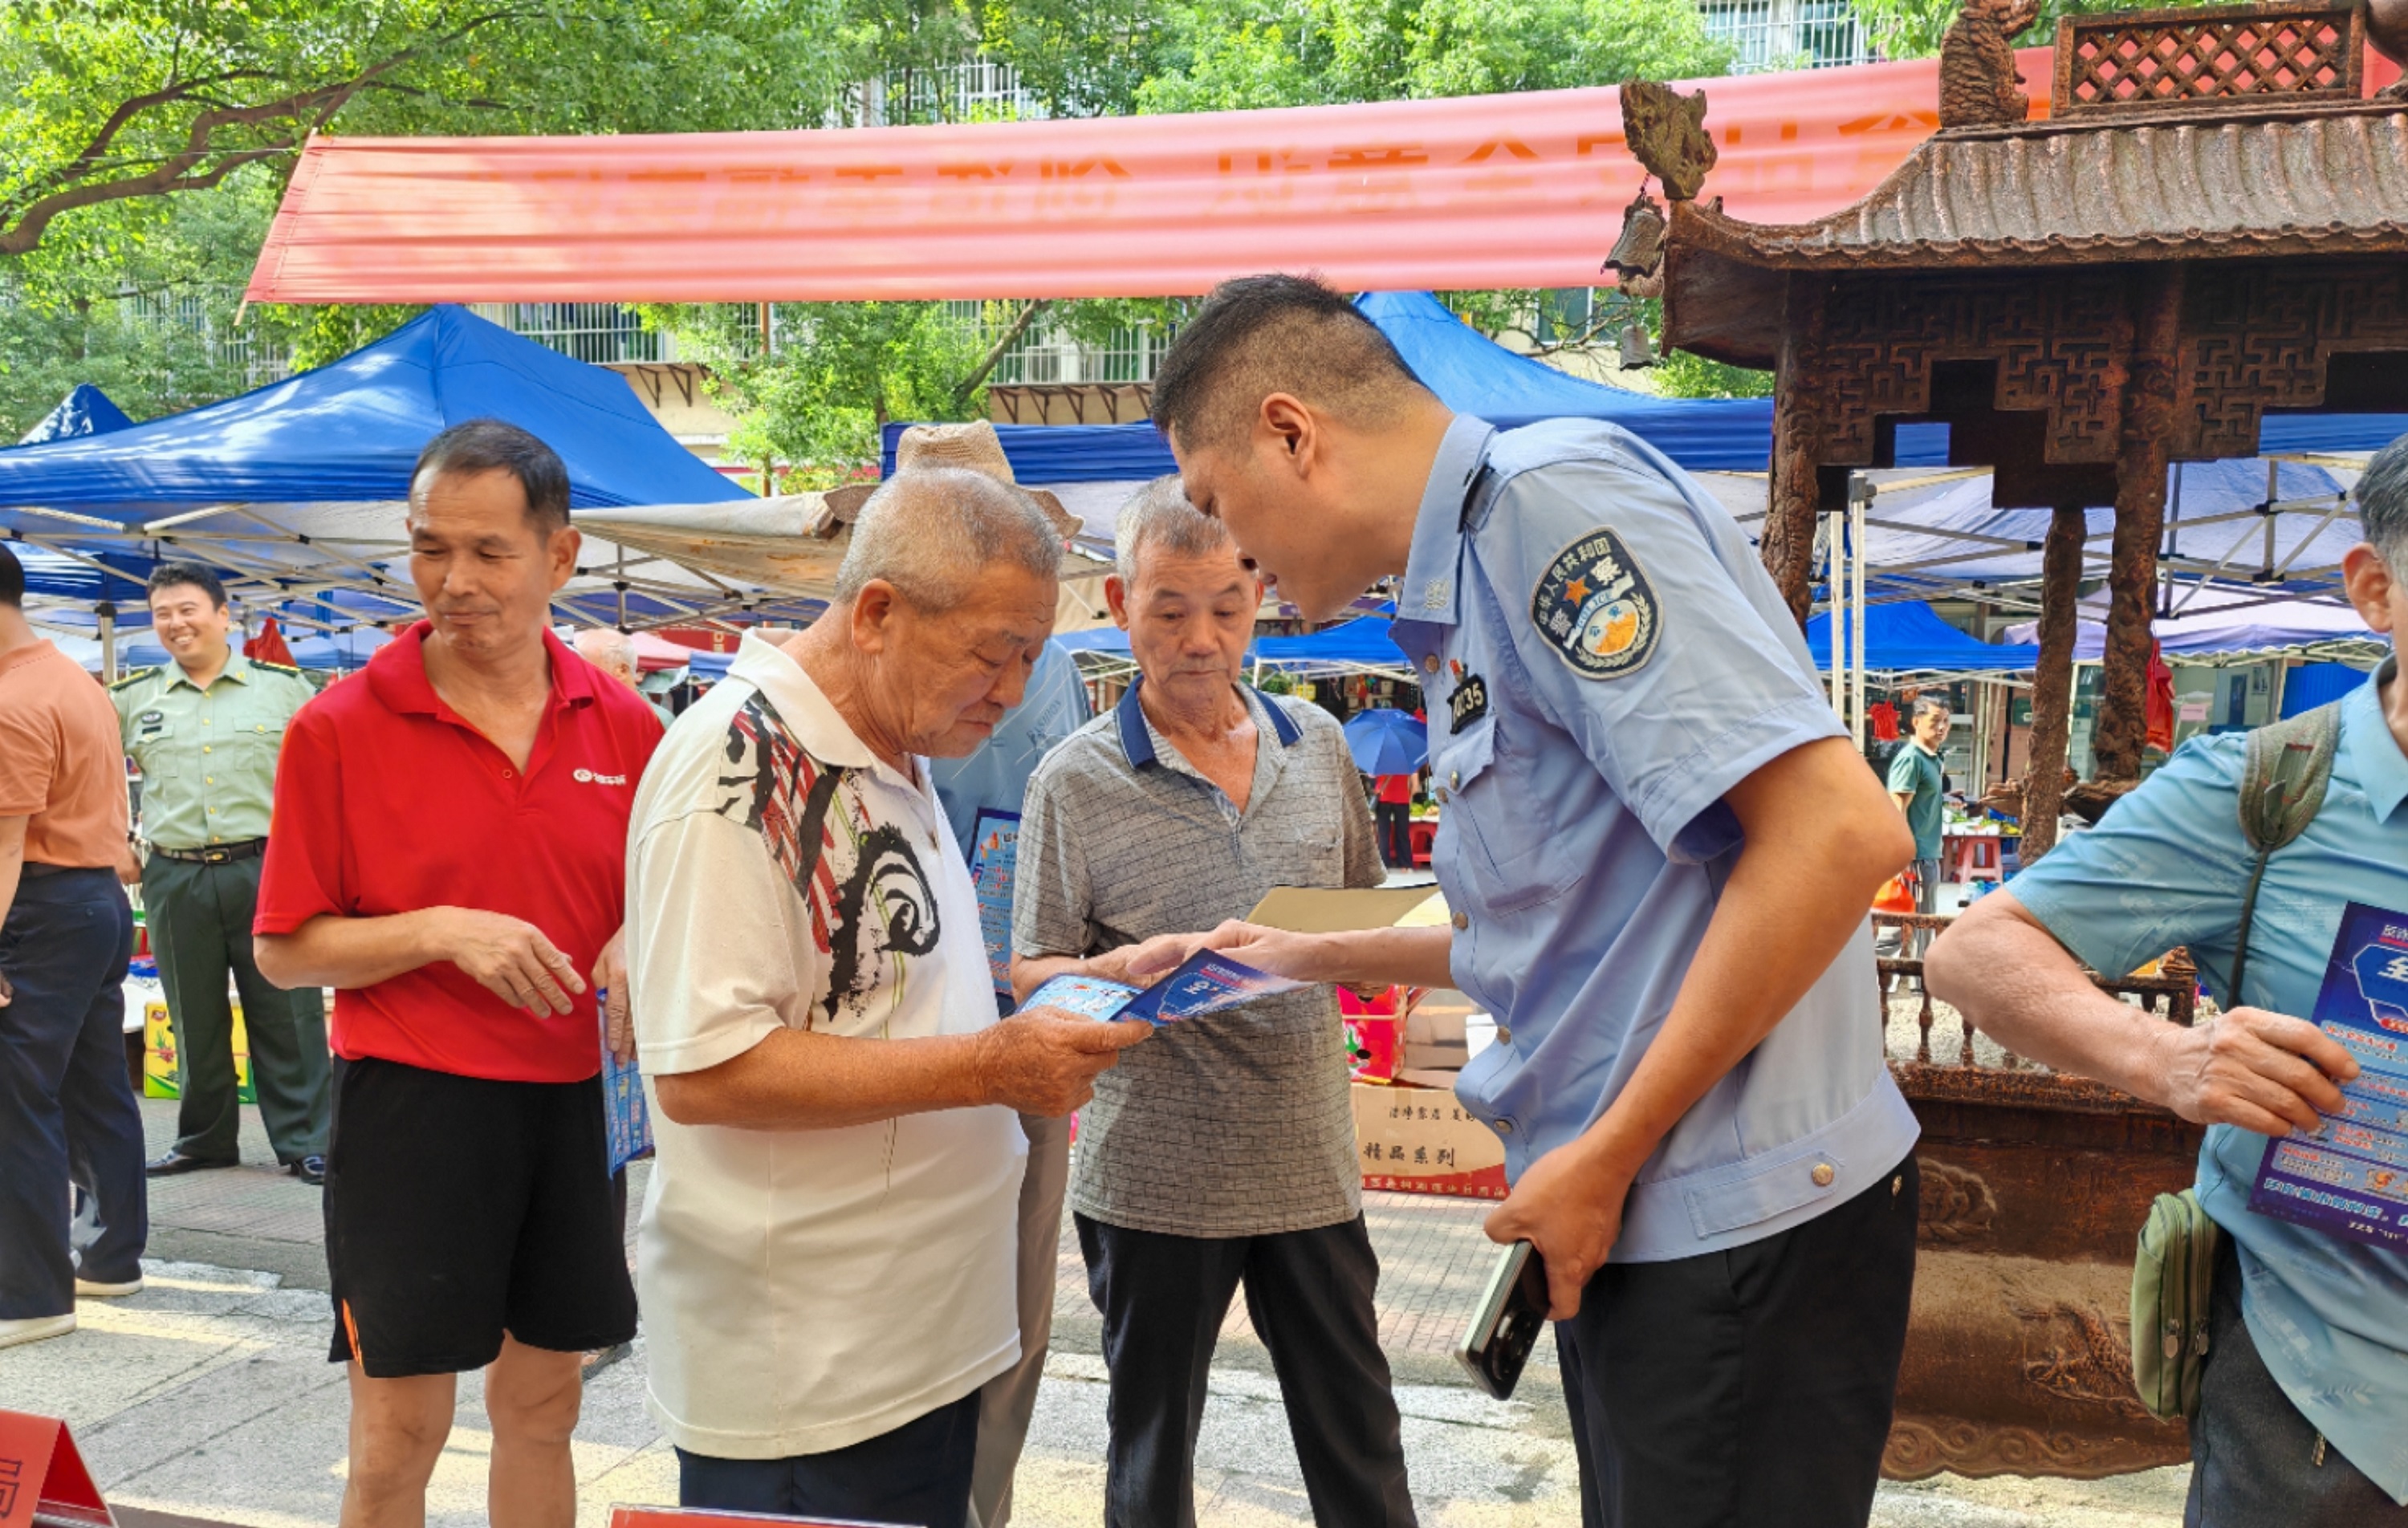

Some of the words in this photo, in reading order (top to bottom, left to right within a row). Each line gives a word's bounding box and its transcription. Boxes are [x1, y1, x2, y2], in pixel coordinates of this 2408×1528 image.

[1538, 537, 1613, 625] 中华人民共和国
[1363, 1142, 1454, 1168] 精品系列
